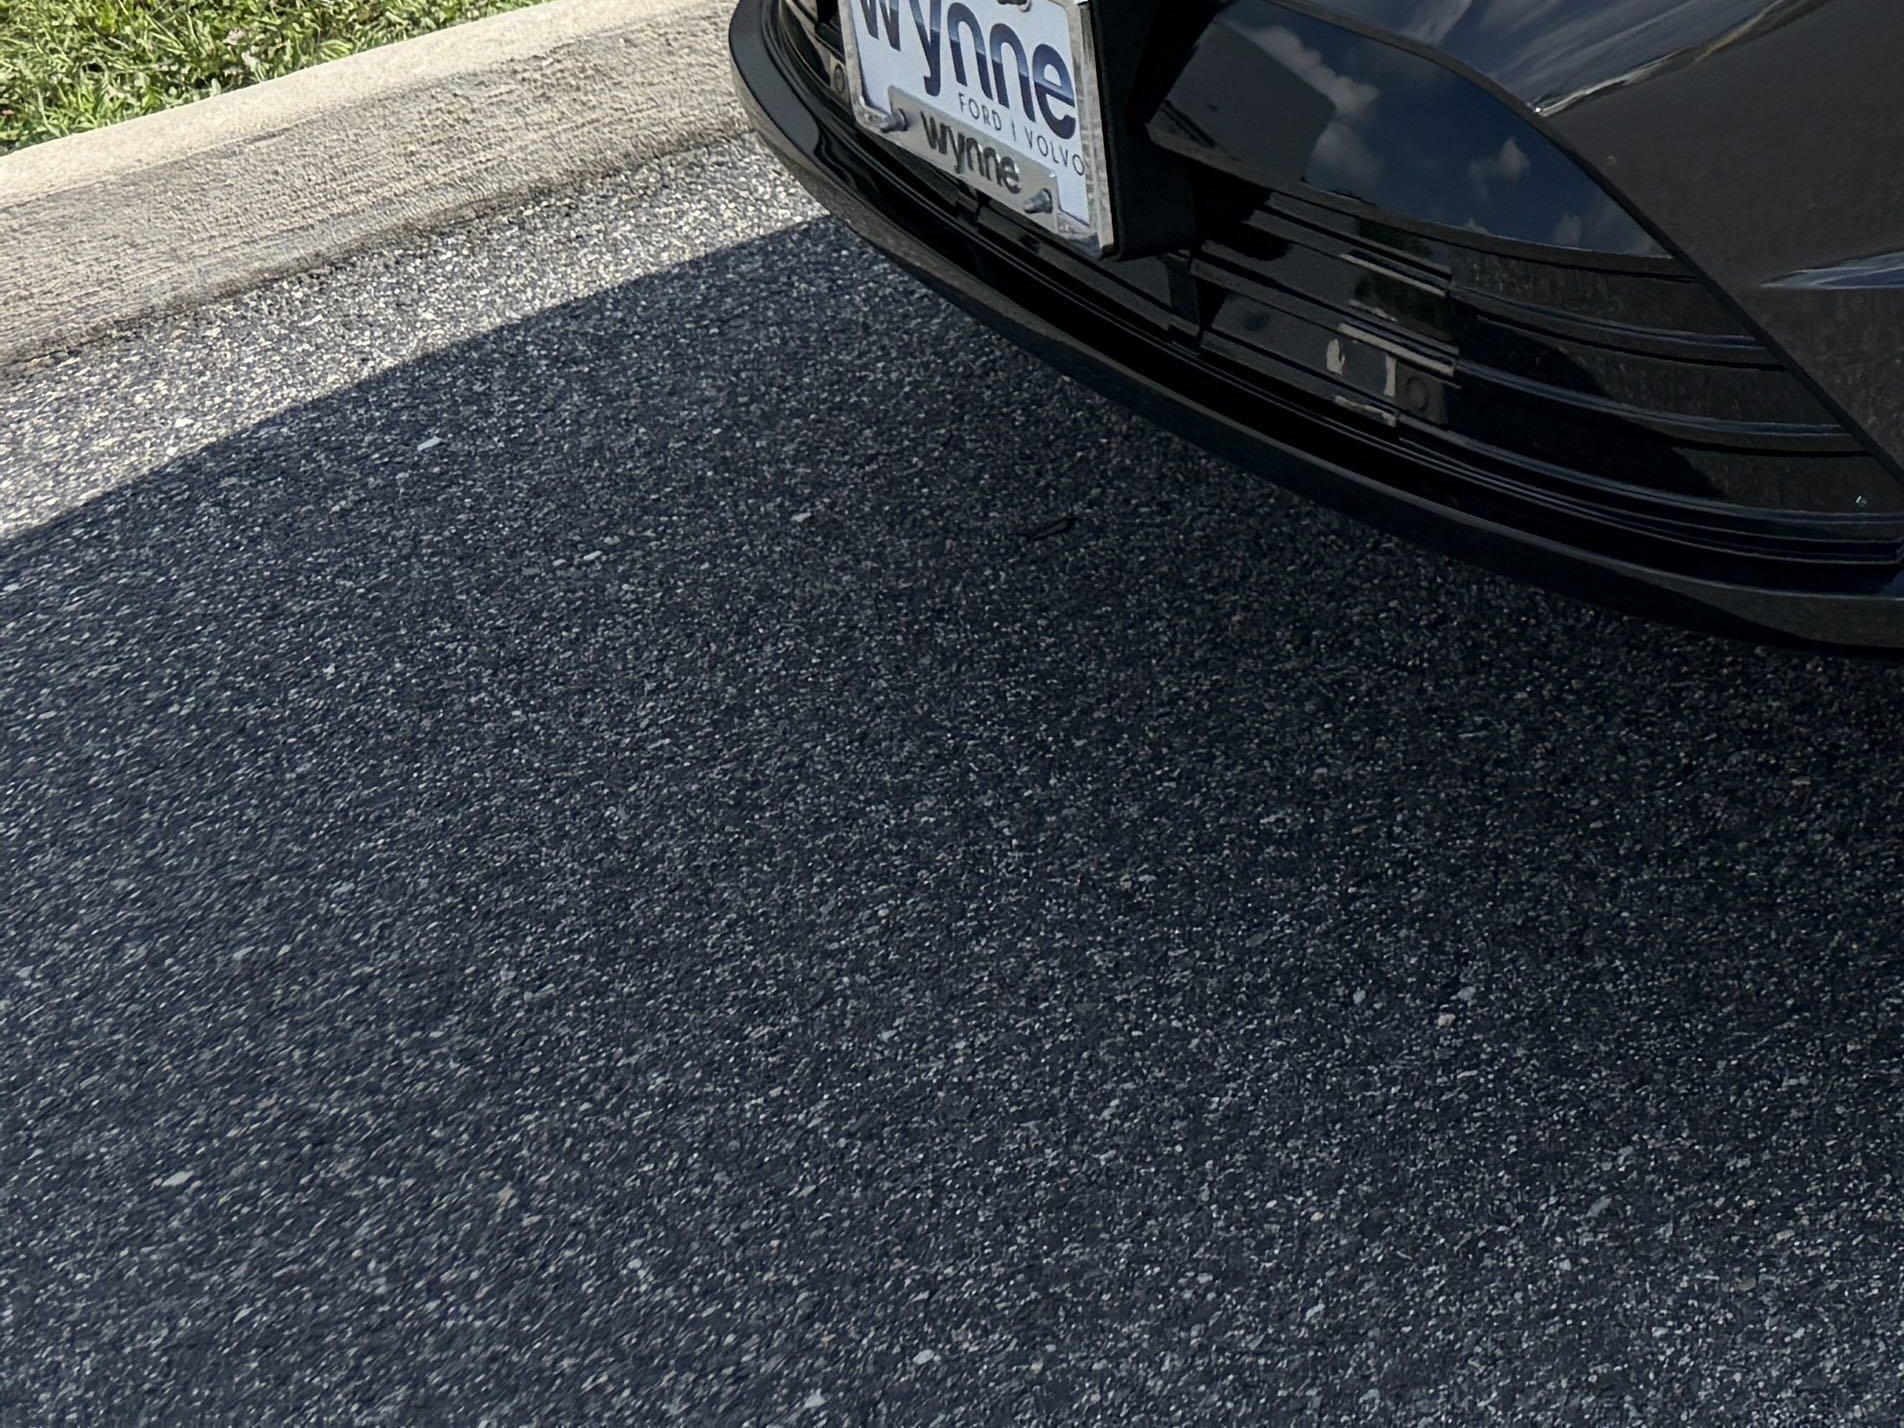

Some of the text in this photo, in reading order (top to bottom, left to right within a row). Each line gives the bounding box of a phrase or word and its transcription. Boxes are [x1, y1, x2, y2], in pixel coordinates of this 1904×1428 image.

[920, 112, 1021, 195] wynne
[959, 92, 1002, 131] FORD
[1024, 127, 1087, 177] VOLVO
